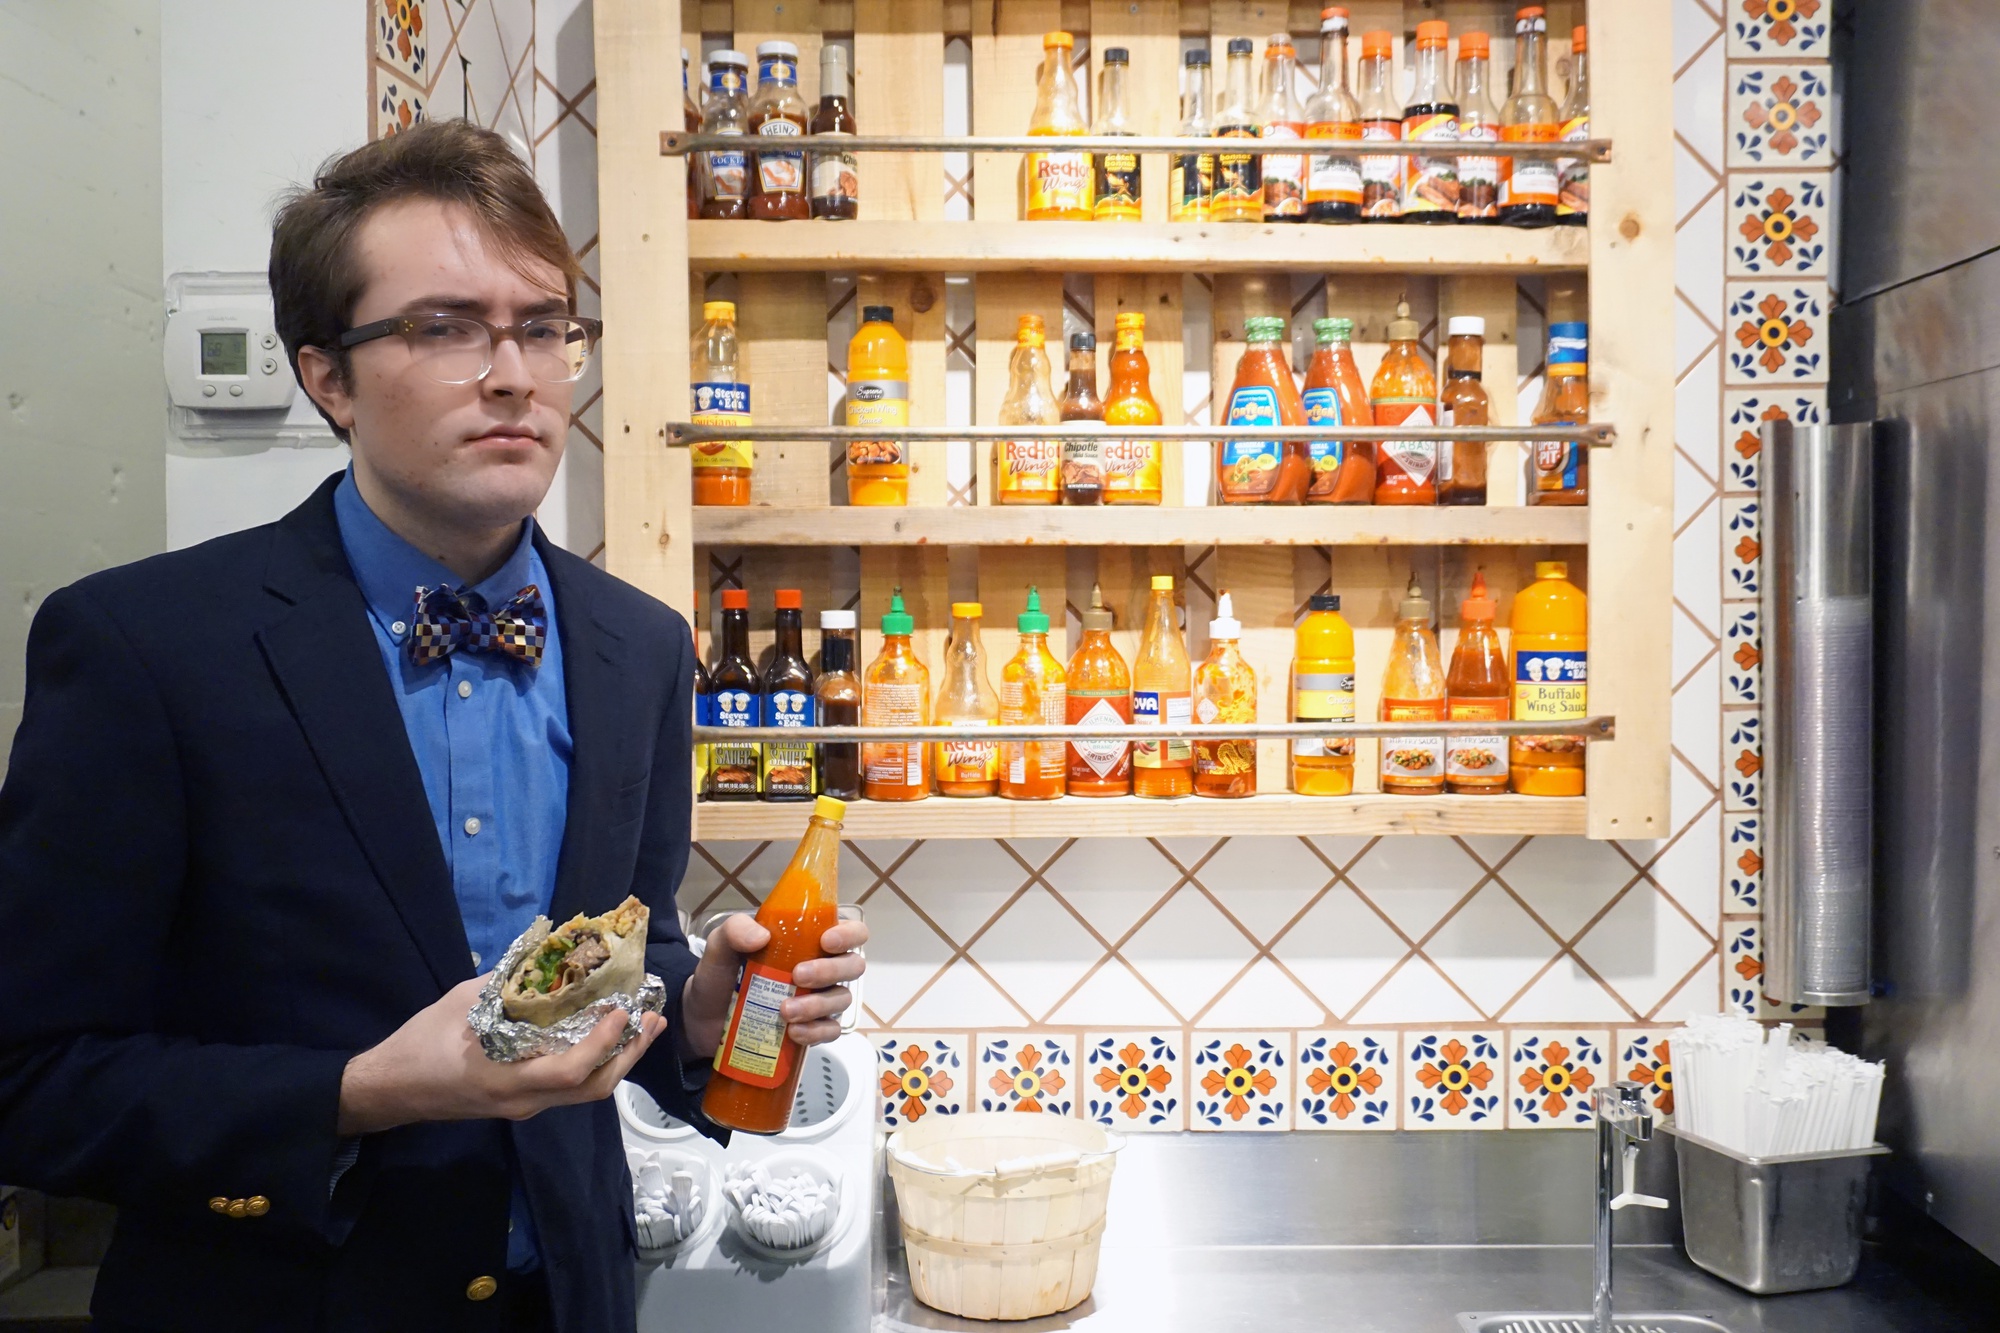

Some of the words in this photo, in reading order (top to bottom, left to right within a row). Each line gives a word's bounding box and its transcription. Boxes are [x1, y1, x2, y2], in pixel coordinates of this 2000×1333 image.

[765, 123, 795, 136] HEINZ
[714, 387, 746, 400] Steve's
[848, 405, 874, 416] Chicken
[876, 405, 897, 417] Wing
[858, 414, 883, 425] Sauce
[1064, 442, 1098, 452] Chipotle
[1009, 459, 1056, 476] Wings
[1538, 687, 1581, 700] Buffalo
[1526, 700, 1556, 714] Wing
[719, 711, 749, 720] Steve's
[775, 712, 805, 721] Steve's
[715, 750, 751, 765] SAUCE
[769, 750, 806, 766] SAUCE
[948, 752, 993, 767] Wings
